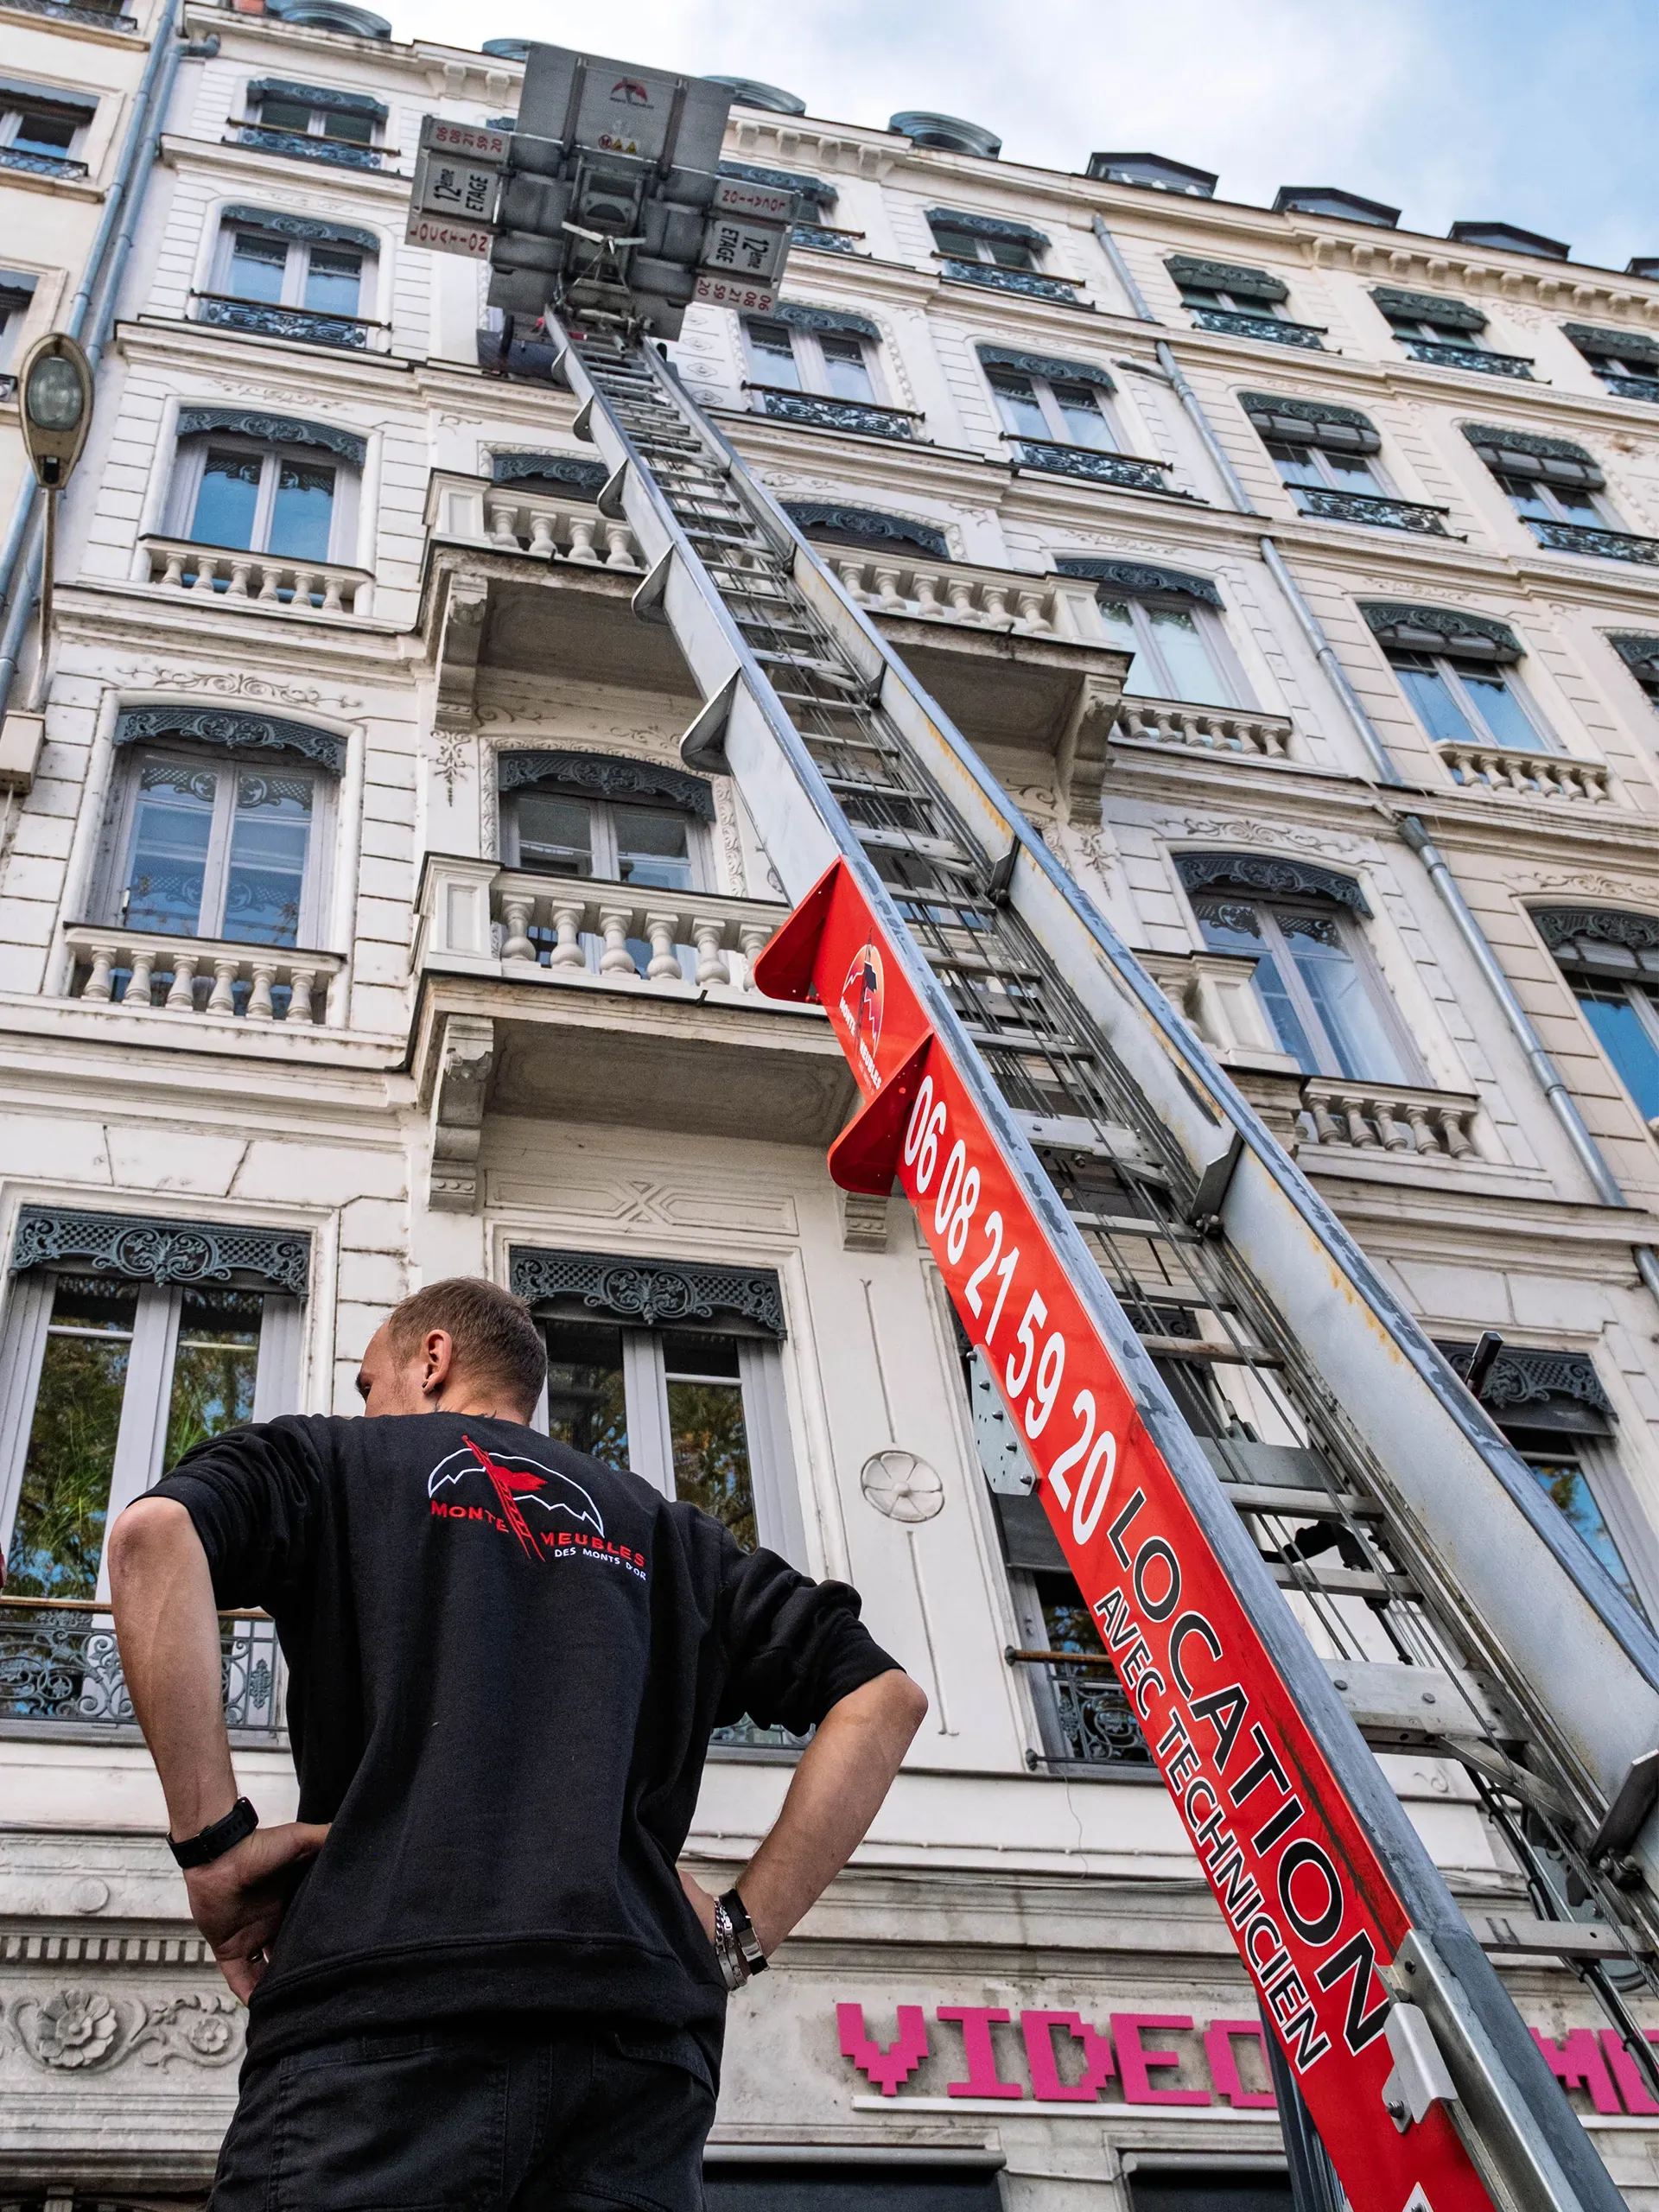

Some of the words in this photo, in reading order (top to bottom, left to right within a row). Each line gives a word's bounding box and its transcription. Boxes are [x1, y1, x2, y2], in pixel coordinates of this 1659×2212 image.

[435, 126, 448, 142] 06
[449, 130, 461, 144] 08
[463, 133, 474, 147] 21
[477, 136, 489, 150] 59
[490, 138, 502, 153] 20
[465, 175, 488, 213] ETAGE
[410, 223, 488, 252] LOCATION
[715, 227, 740, 264] ETAGE
[697, 279, 711, 296] 20
[713, 283, 726, 300] 59
[728, 288, 742, 303] 21
[743, 291, 757, 308] 08
[758, 295, 772, 311] 06
[904, 1075, 947, 1194] 06
[934, 1139, 981, 1265] 08
[964, 1211, 1020, 1346] 21
[1006, 1289, 1065, 1440] 59
[1048, 1389, 1116, 1545] 20
[430, 1500, 510, 1534] MONTE
[539, 1531, 646, 1568] MEUBLES
[554, 1547, 577, 1558] DES
[582, 1548, 621, 1566] MONTS
[1107, 1486, 1389, 2057] LOCATION
[1092, 1586, 1168, 1721] AVEC
[1155, 1710, 1332, 2075] TECHNICIEN
